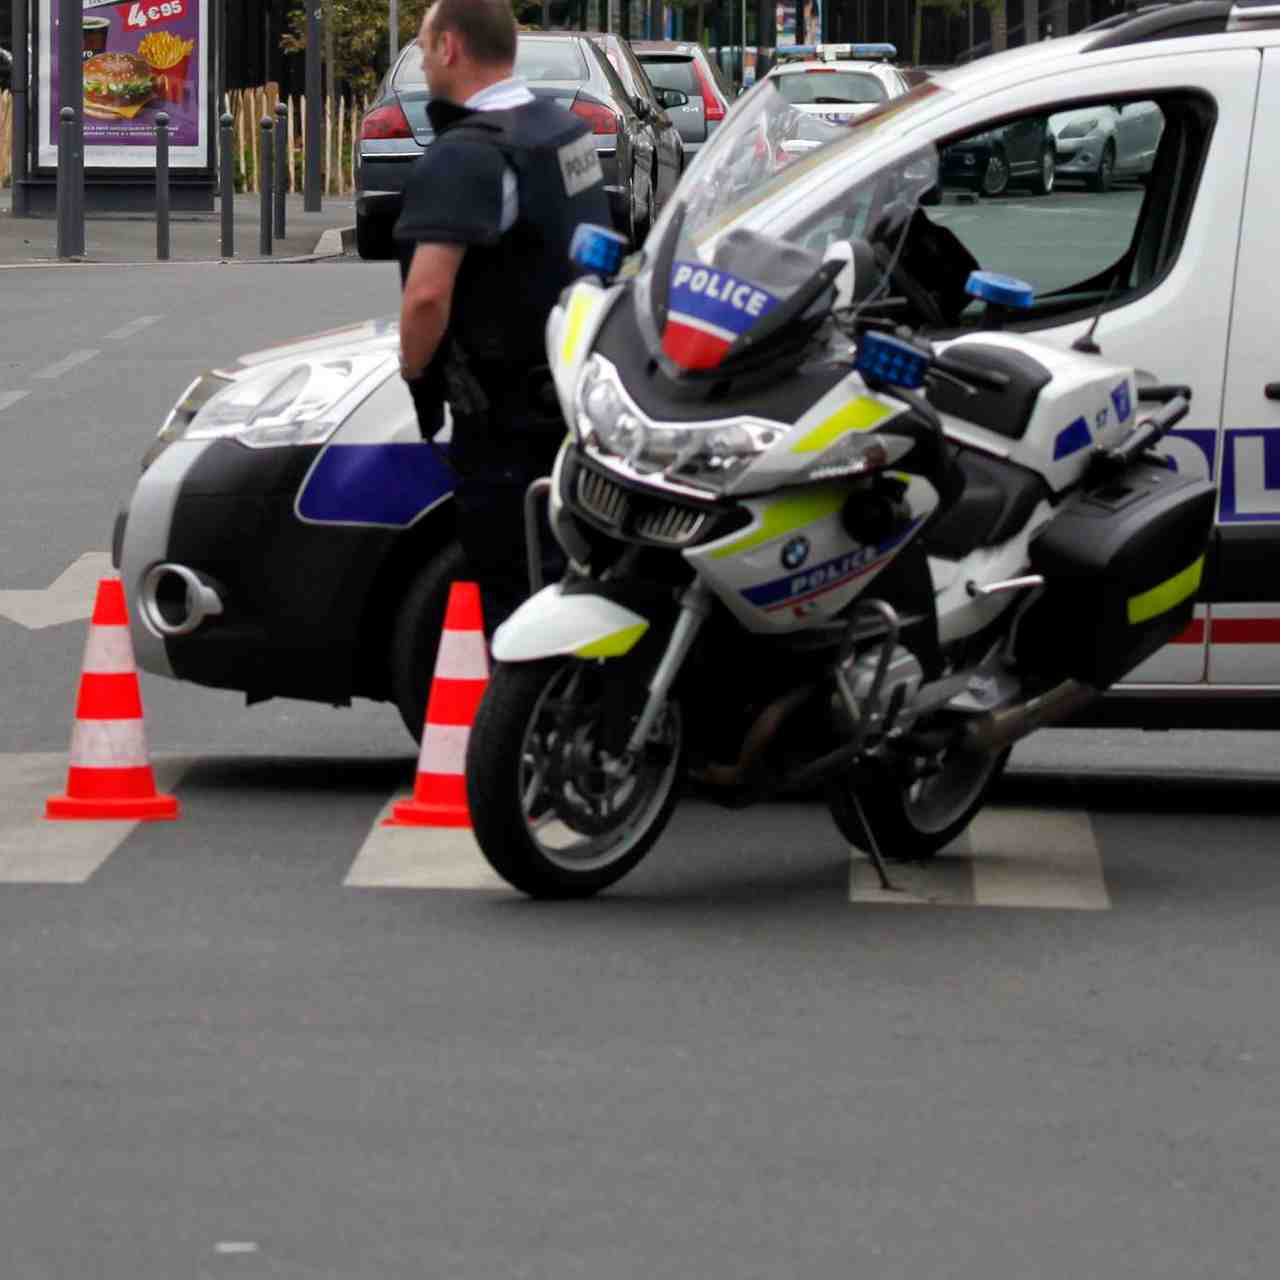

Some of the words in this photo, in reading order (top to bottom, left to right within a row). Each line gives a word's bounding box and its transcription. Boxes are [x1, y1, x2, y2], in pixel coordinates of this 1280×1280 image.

[127, 0, 183, 28] 4€95
[672, 264, 768, 318] POLICE
[790, 543, 879, 599] POLICE
